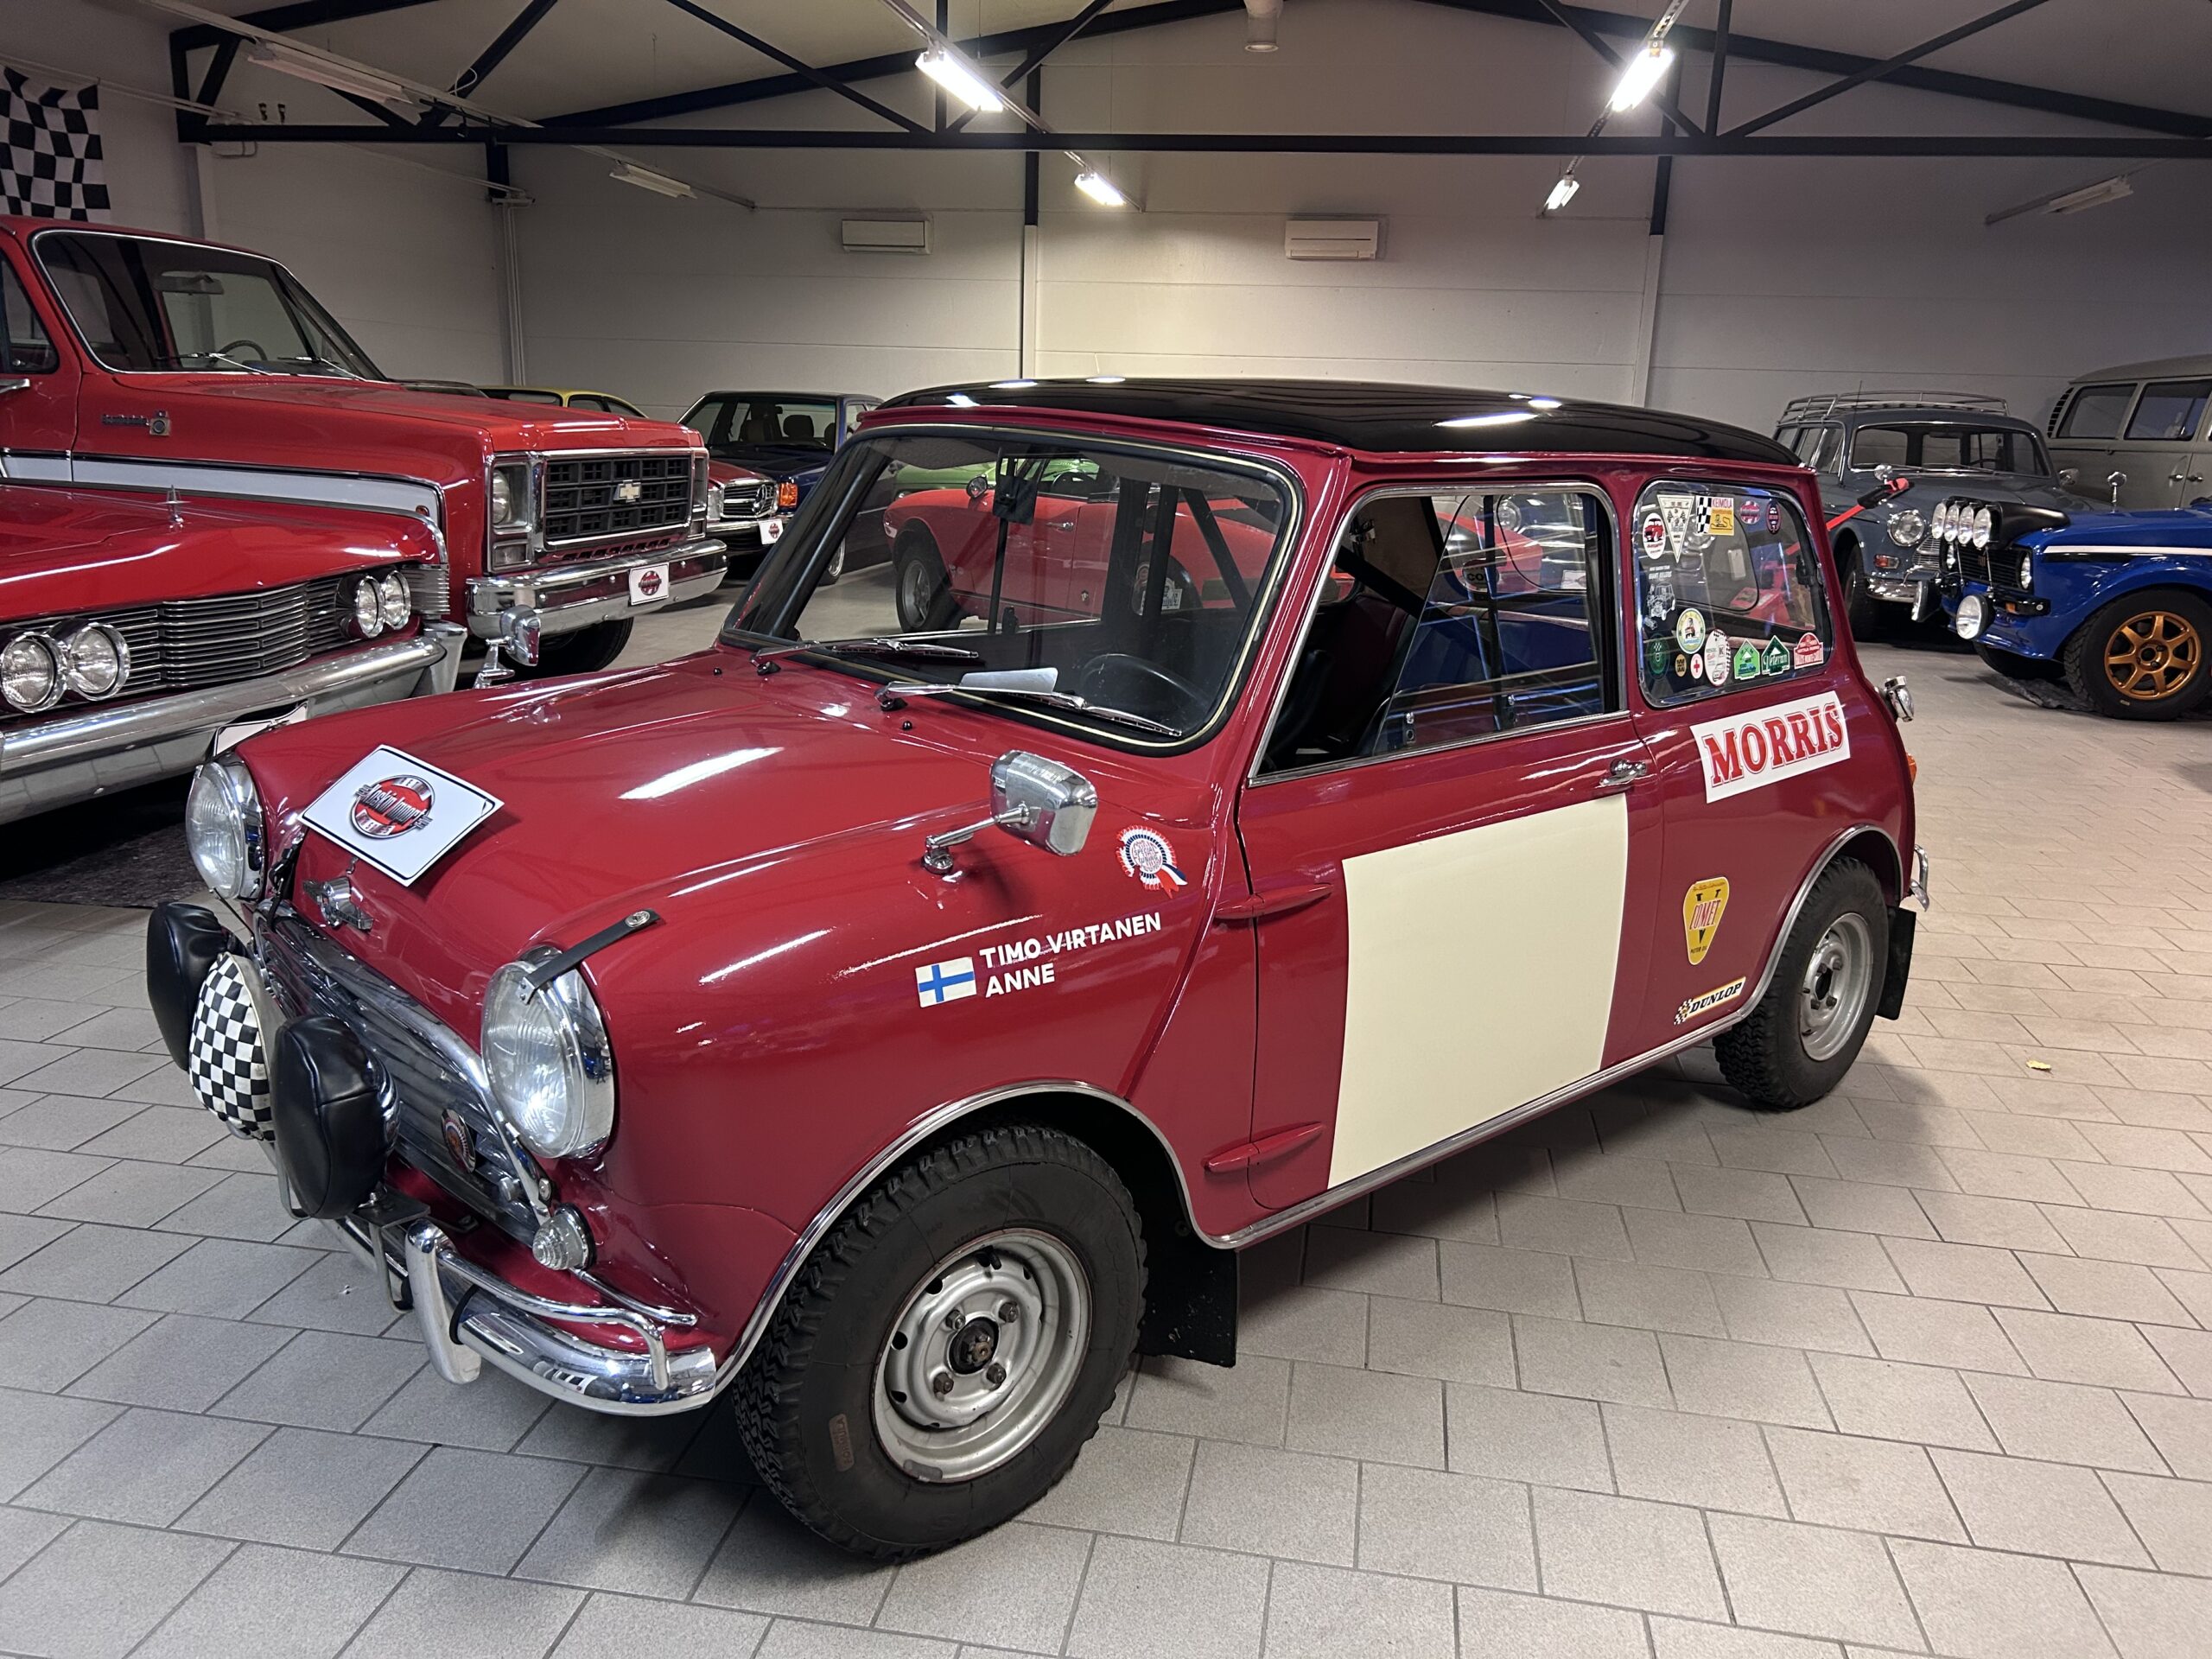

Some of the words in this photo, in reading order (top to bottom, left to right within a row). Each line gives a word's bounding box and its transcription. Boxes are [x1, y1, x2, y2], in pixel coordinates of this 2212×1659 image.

[1701, 702, 1844, 787] MORRIS
[1689, 899, 1721, 930] COMET
[979, 938, 1041, 969] TIMO
[1046, 912, 1161, 954] VIRTANEN
[985, 963, 1055, 998] ANNE
[1690, 982, 1743, 1014] DUNLOP
